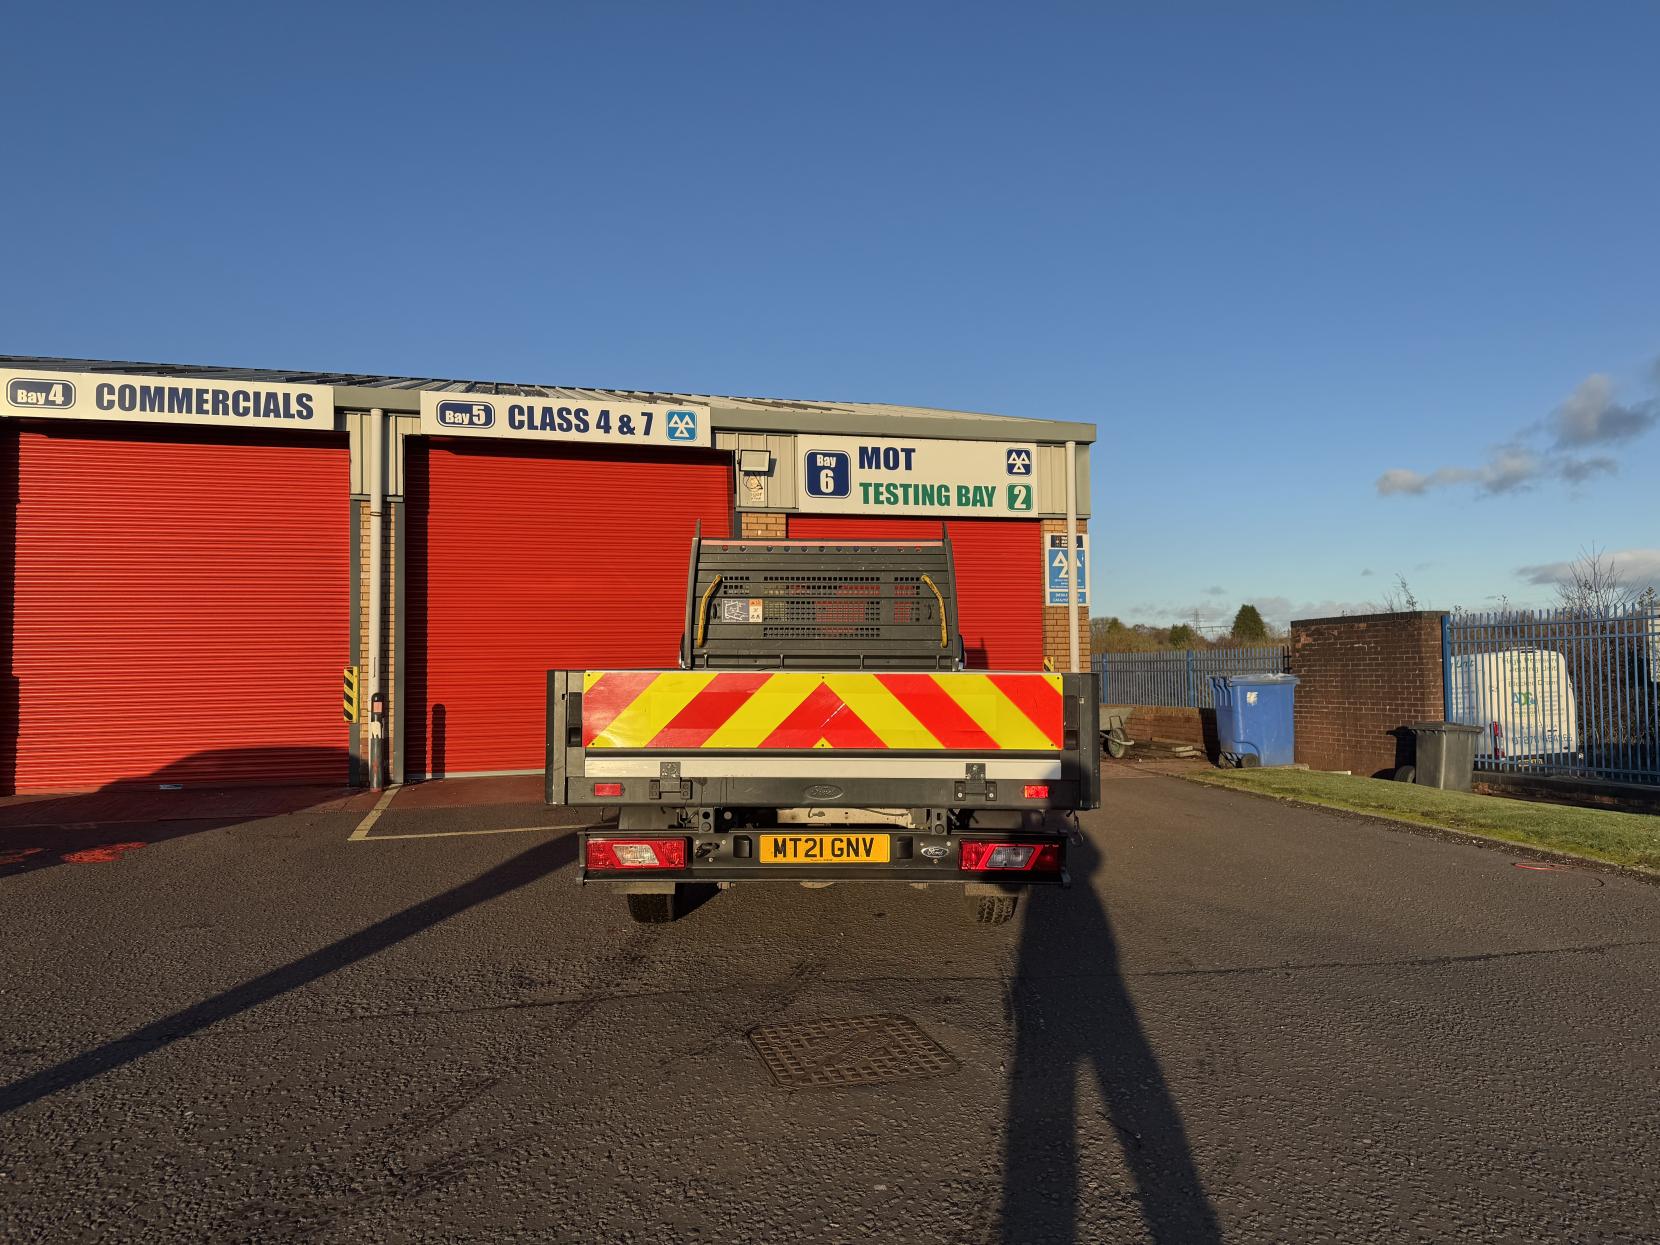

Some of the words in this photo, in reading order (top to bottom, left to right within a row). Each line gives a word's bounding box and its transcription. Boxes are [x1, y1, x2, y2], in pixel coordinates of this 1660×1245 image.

[17, 389, 46, 405] Bay
[48, 383, 64, 405] 4
[95, 383, 314, 420] COMMERCIALS
[445, 410, 470, 426] Bay
[472, 405, 486, 424] 5
[508, 405, 590, 434] CLASS
[595, 410, 611, 434] 4
[618, 414, 635, 435] &
[640, 411, 654, 436] 7
[816, 454, 837, 468] Bay
[858, 446, 916, 471] MOT
[819, 469, 835, 494] 6
[859, 482, 950, 507] TESTING
[956, 485, 997, 508] BAY
[1013, 485, 1027, 509] 2
[773, 837, 824, 858] MT21
[831, 837, 875, 858] GNV
[924, 847, 944, 856] Ford
